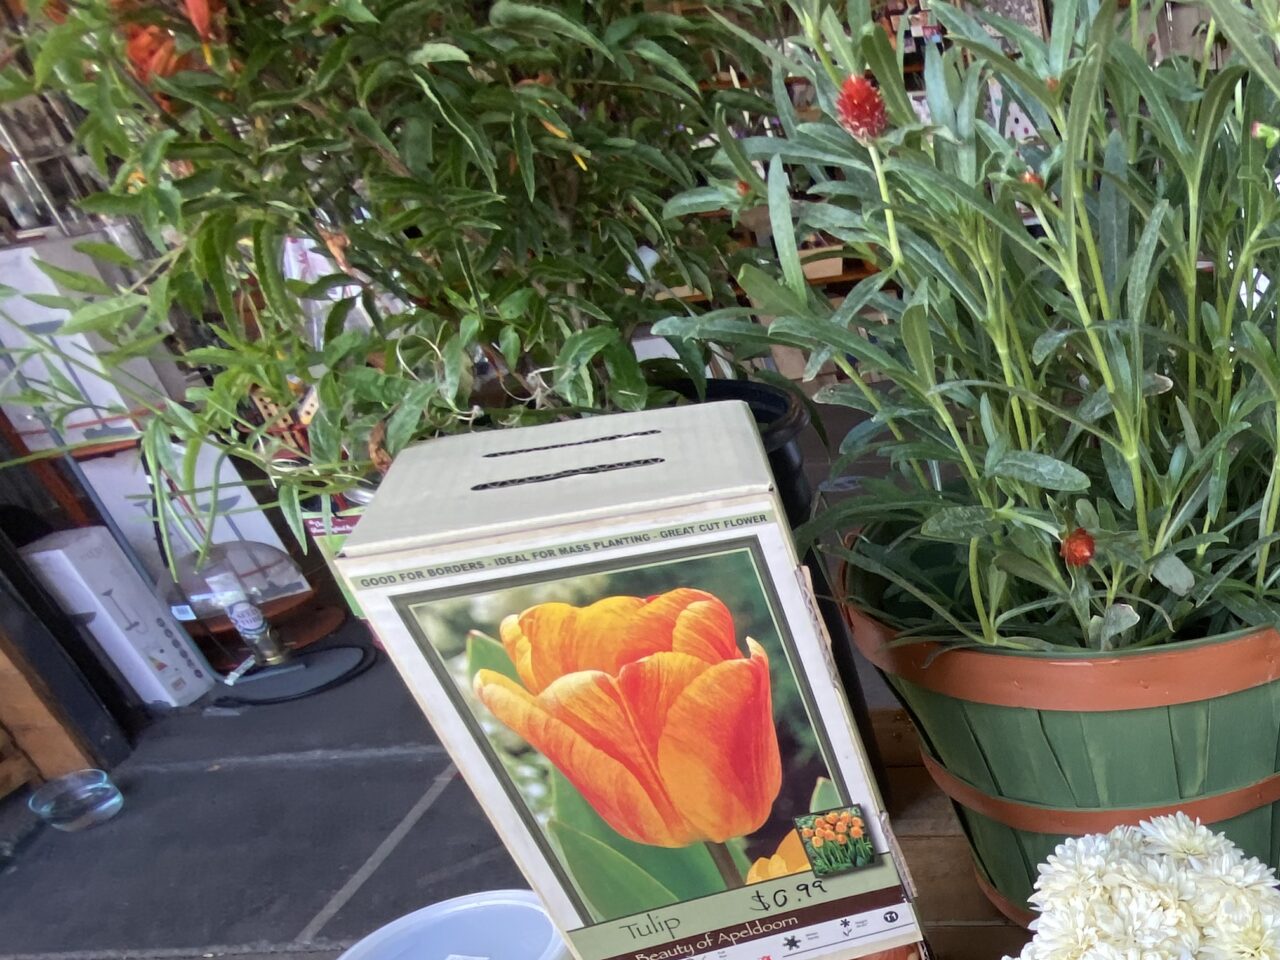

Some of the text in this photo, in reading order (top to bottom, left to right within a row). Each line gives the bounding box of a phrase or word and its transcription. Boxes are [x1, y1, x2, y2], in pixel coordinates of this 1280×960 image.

[360, 575, 397, 588] GOOD
[399, 570, 426, 583] FOR
[428, 560, 485, 577] BORDERS
[494, 554, 529, 567] IDEAL
[532, 549, 556, 561] FOR
[558, 544, 592, 557] MASS
[594, 533, 650, 550] PLANTING
[659, 526, 695, 539] GREAT
[699, 522, 721, 532] CUT
[724, 514, 768, 528] FLOWER
[750, 879, 828, 912] $0.99
[618, 913, 681, 940] Tulip
[696, 932, 714, 949] of
[716, 914, 799, 946] Apeldoorn
